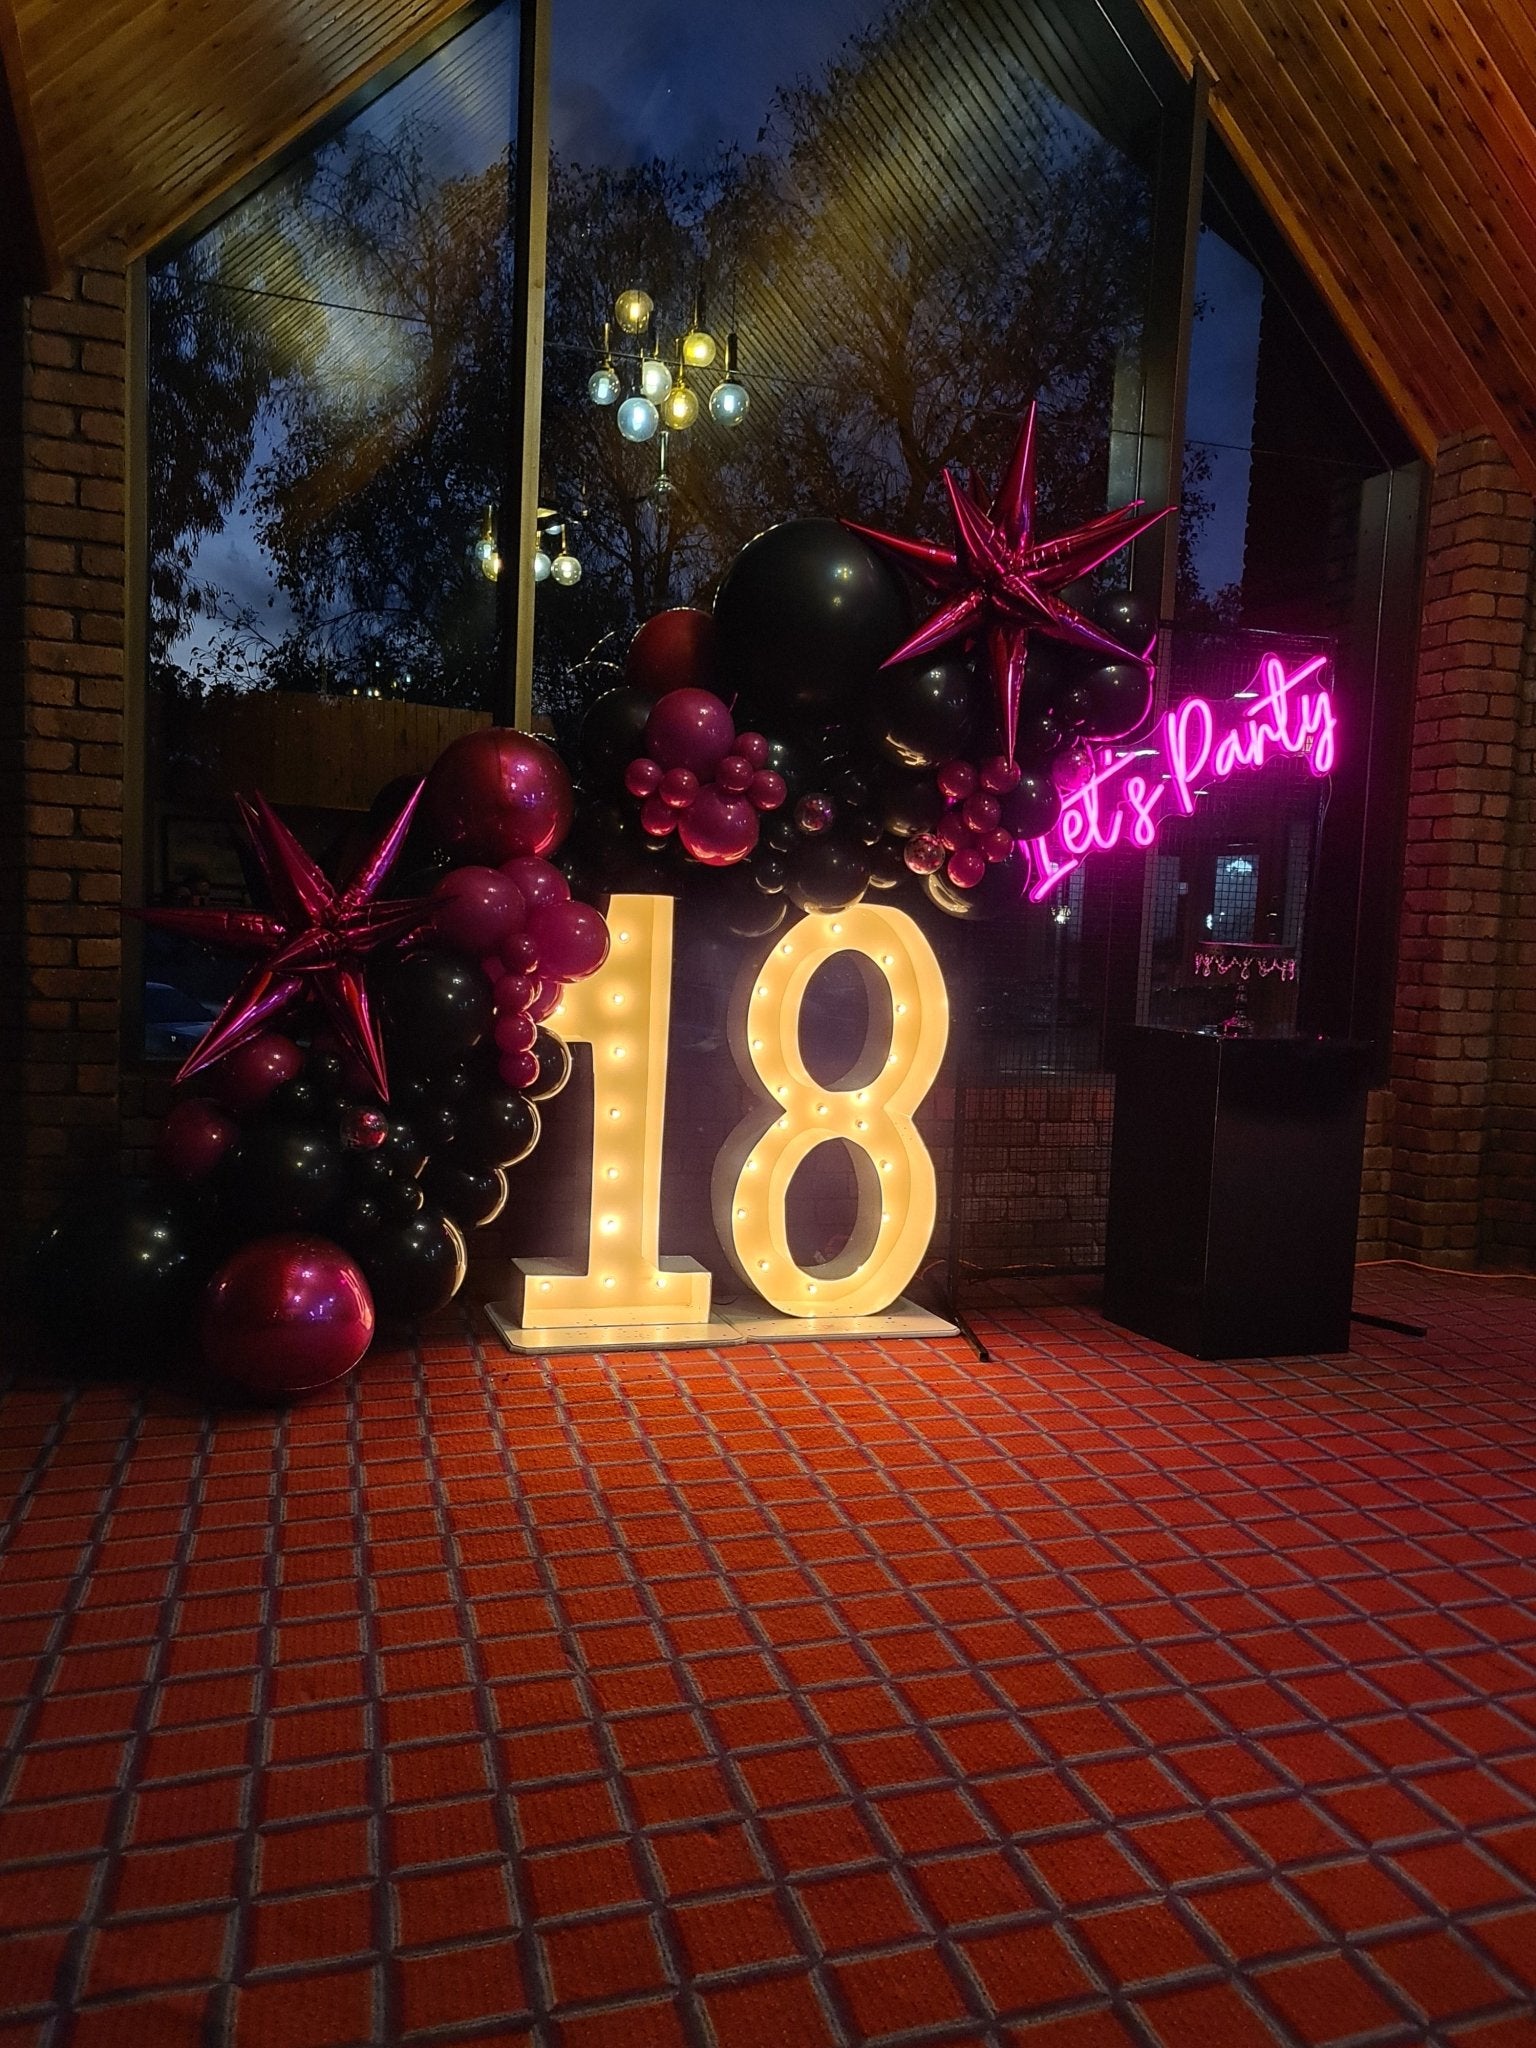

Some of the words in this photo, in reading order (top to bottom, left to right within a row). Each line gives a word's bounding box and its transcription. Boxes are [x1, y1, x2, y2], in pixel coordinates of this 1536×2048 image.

[1028, 748, 1167, 904] Let's
[1164, 654, 1337, 814] Party
[520, 893, 950, 1329] 18
